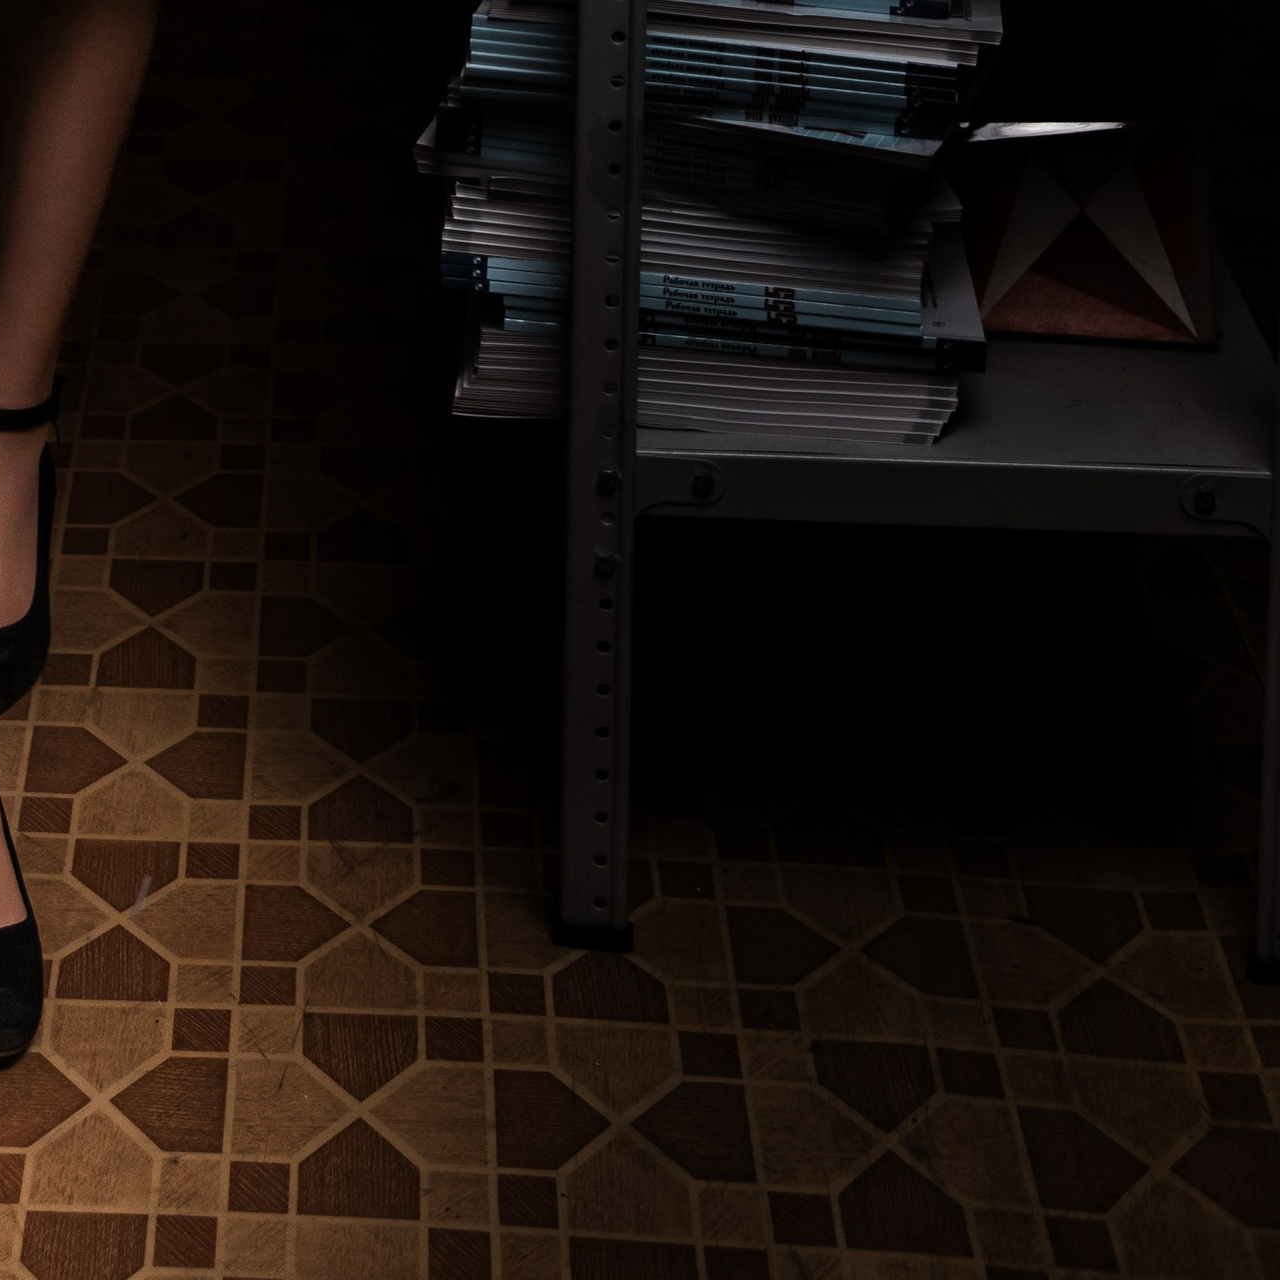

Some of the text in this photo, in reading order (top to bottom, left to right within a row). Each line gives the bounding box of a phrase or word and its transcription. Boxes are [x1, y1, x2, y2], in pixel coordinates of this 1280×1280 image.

[663, 275, 699, 289] Рабочая
[701, 280, 736, 292] тетрадь
[662, 287, 699, 300] Рабочая
[700, 293, 736, 304] тетрадь
[665, 300, 701, 313] Рабочая
[703, 306, 738, 318] тетрадь
